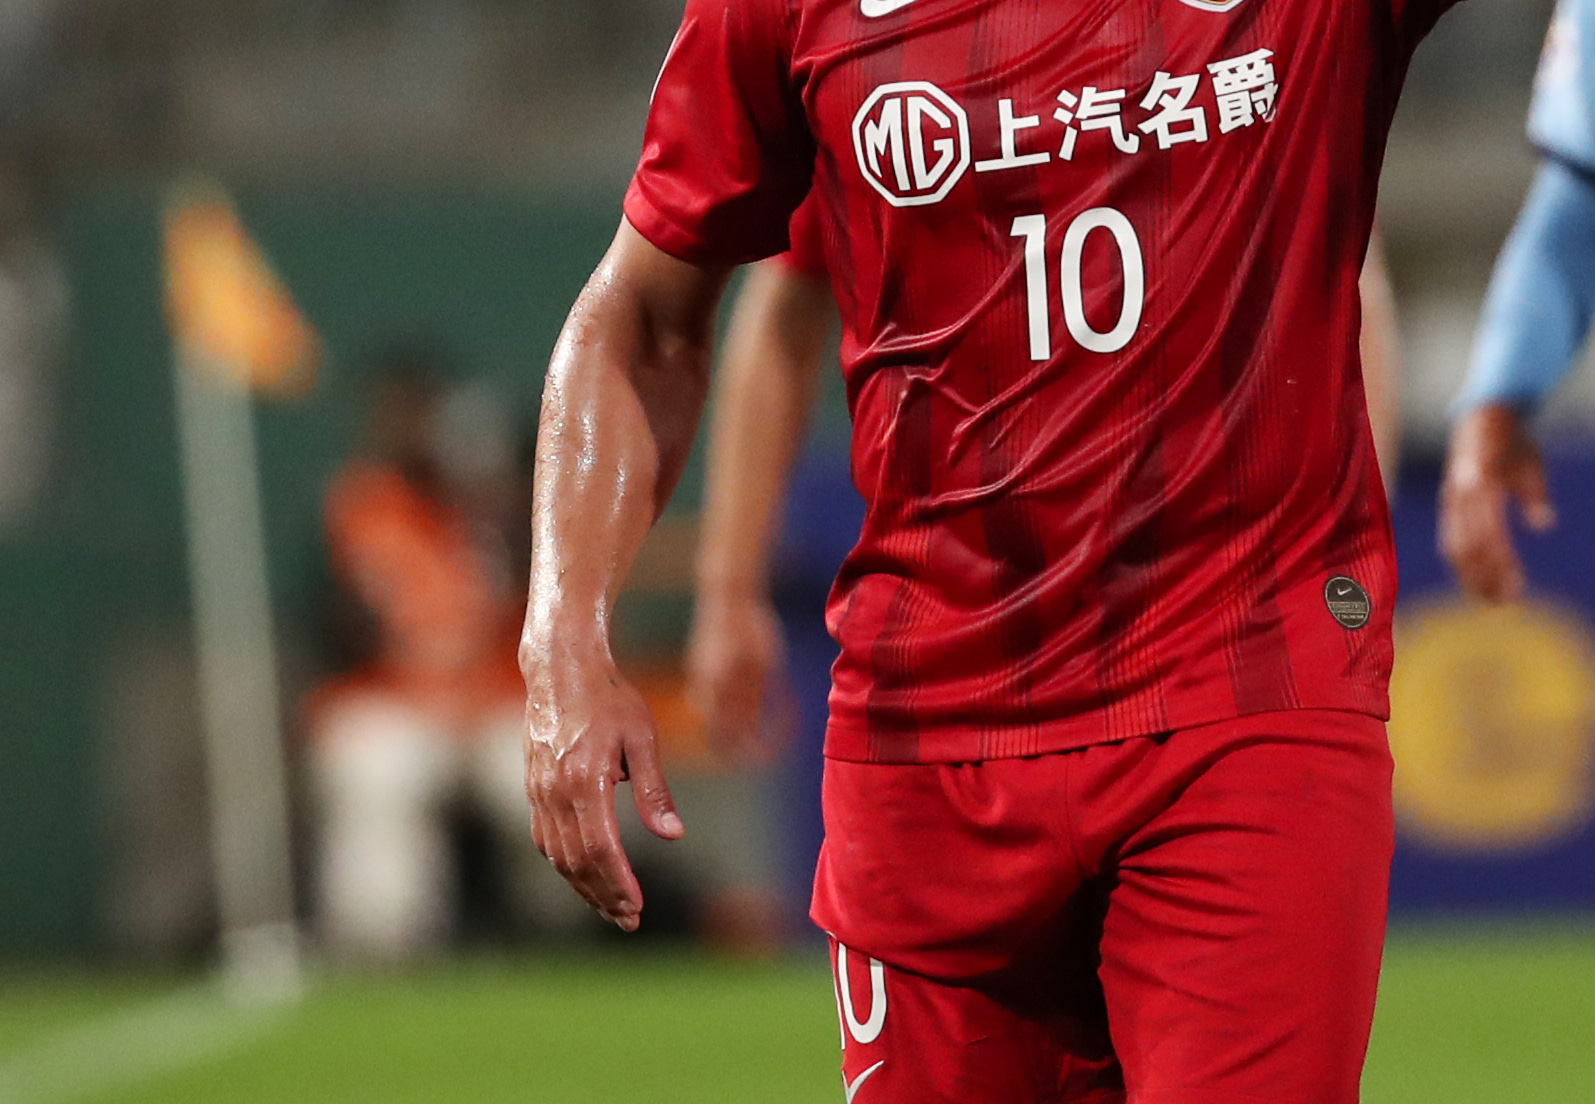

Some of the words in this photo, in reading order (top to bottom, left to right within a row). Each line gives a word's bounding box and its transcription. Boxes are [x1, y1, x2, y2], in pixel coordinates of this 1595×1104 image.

[863, 93, 957, 193] MG
[974, 47, 1279, 173] 上汽名爵
[1009, 206, 1145, 362] 10
